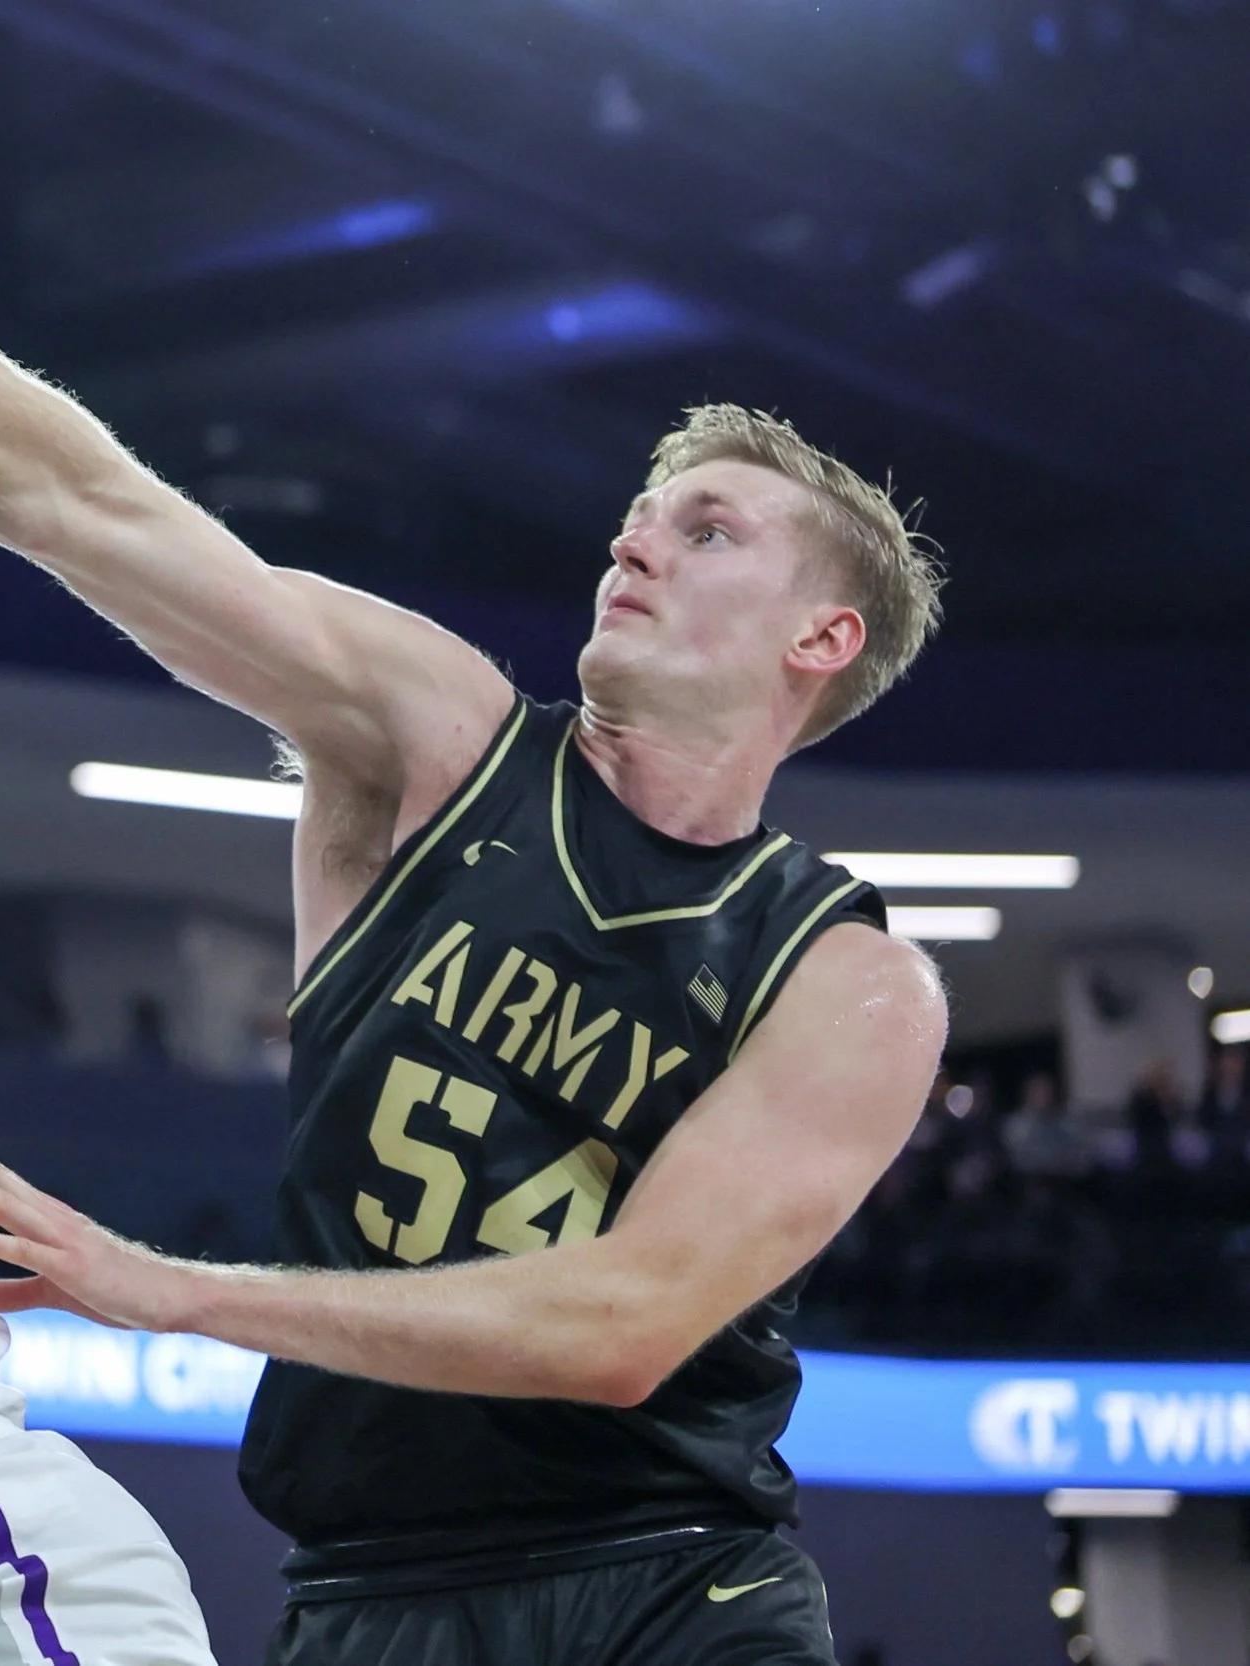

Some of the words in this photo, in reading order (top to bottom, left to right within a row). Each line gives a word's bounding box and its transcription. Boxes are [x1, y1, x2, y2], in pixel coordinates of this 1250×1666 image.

[391, 920, 690, 1130] ARMY
[354, 1055, 618, 1266] 54
[7, 1326, 138, 1410] WIN
